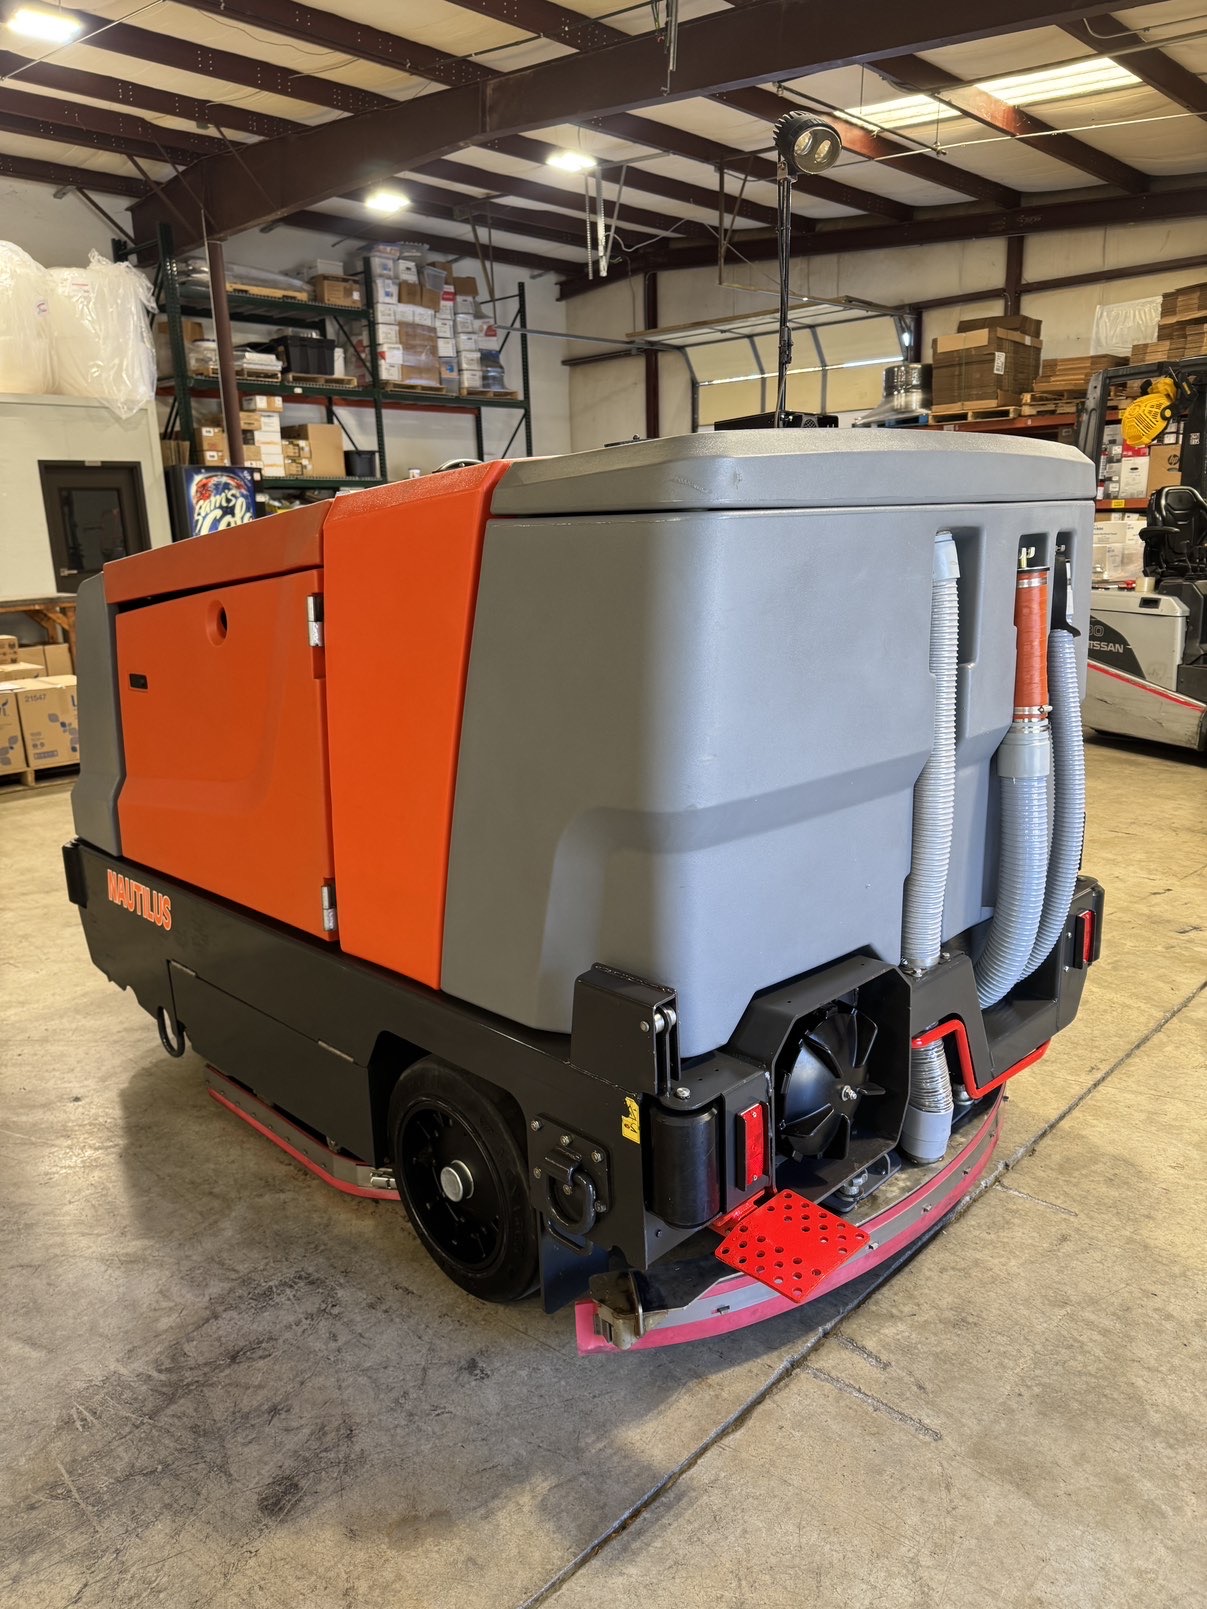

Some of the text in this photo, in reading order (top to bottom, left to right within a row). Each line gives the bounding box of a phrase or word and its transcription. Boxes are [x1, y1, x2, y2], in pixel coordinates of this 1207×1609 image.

[1168, 454, 1180, 466] hp
[194, 489, 240, 532] Sam's
[1088, 641, 1124, 653] ISSAN
[107, 868, 172, 931] NAUTILUS
